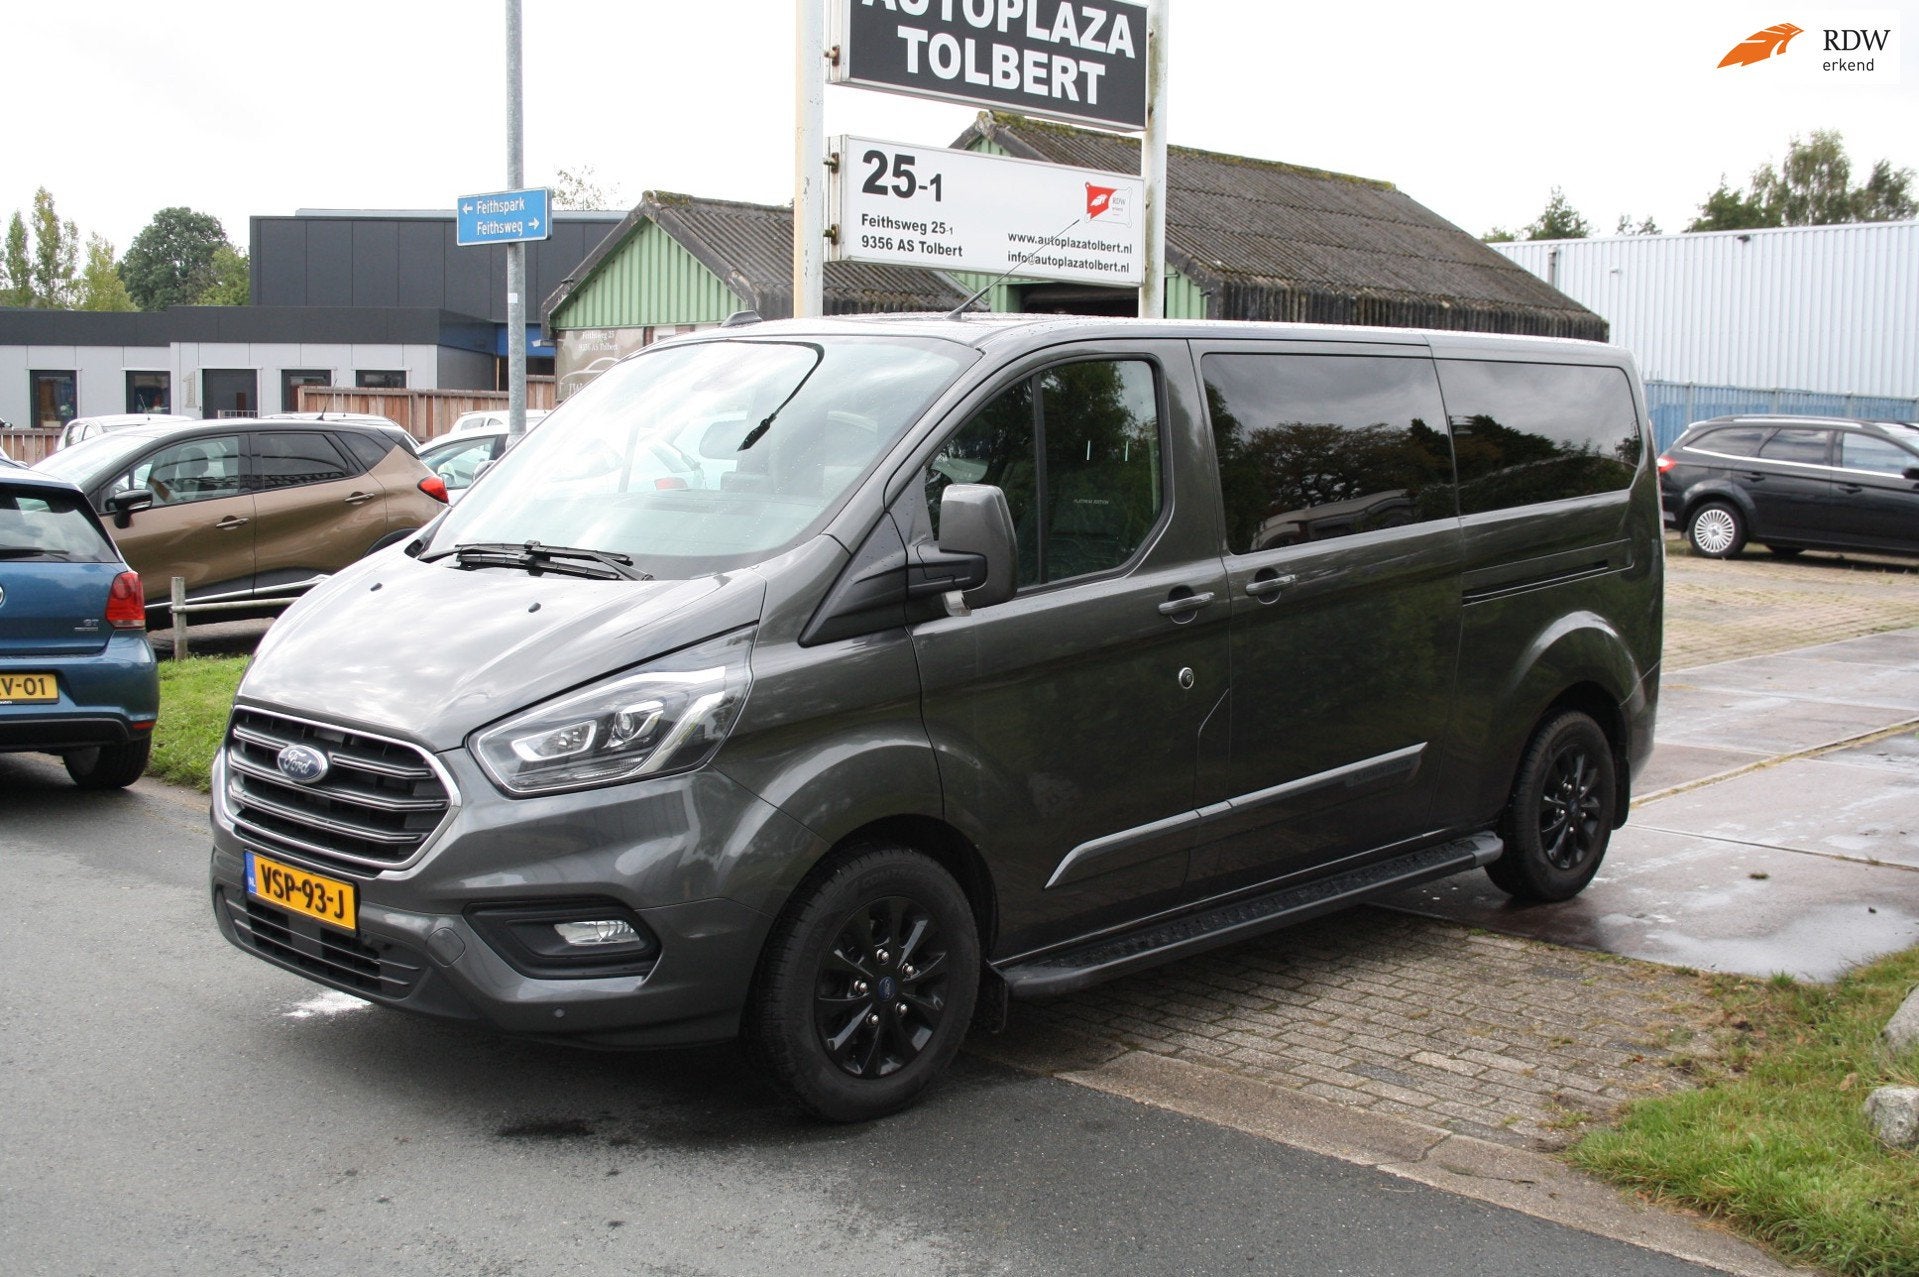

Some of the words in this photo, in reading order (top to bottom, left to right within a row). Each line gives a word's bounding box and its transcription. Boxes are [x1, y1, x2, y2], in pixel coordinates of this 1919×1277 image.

[861, 0, 1135, 58] OPLAZA
[897, 25, 1106, 104] TOLBERT
[862, 150, 942, 202] 25-1
[477, 197, 525, 215] Feithspark
[477, 221, 523, 236] Feithsweg
[861, 213, 927, 235] Feithsweg
[861, 235, 893, 251] 9356
[897, 238, 915, 252] AS
[918, 241, 963, 257] Tolbert
[1008, 232, 1132, 254] www.autoplazatolbert.nl
[1008, 251, 1130, 273] info@autoplazatolbert.nl
[0, 677, 46, 696] V-01
[282, 750, 312, 775] Ford
[260, 862, 345, 919] VSP-93-J
